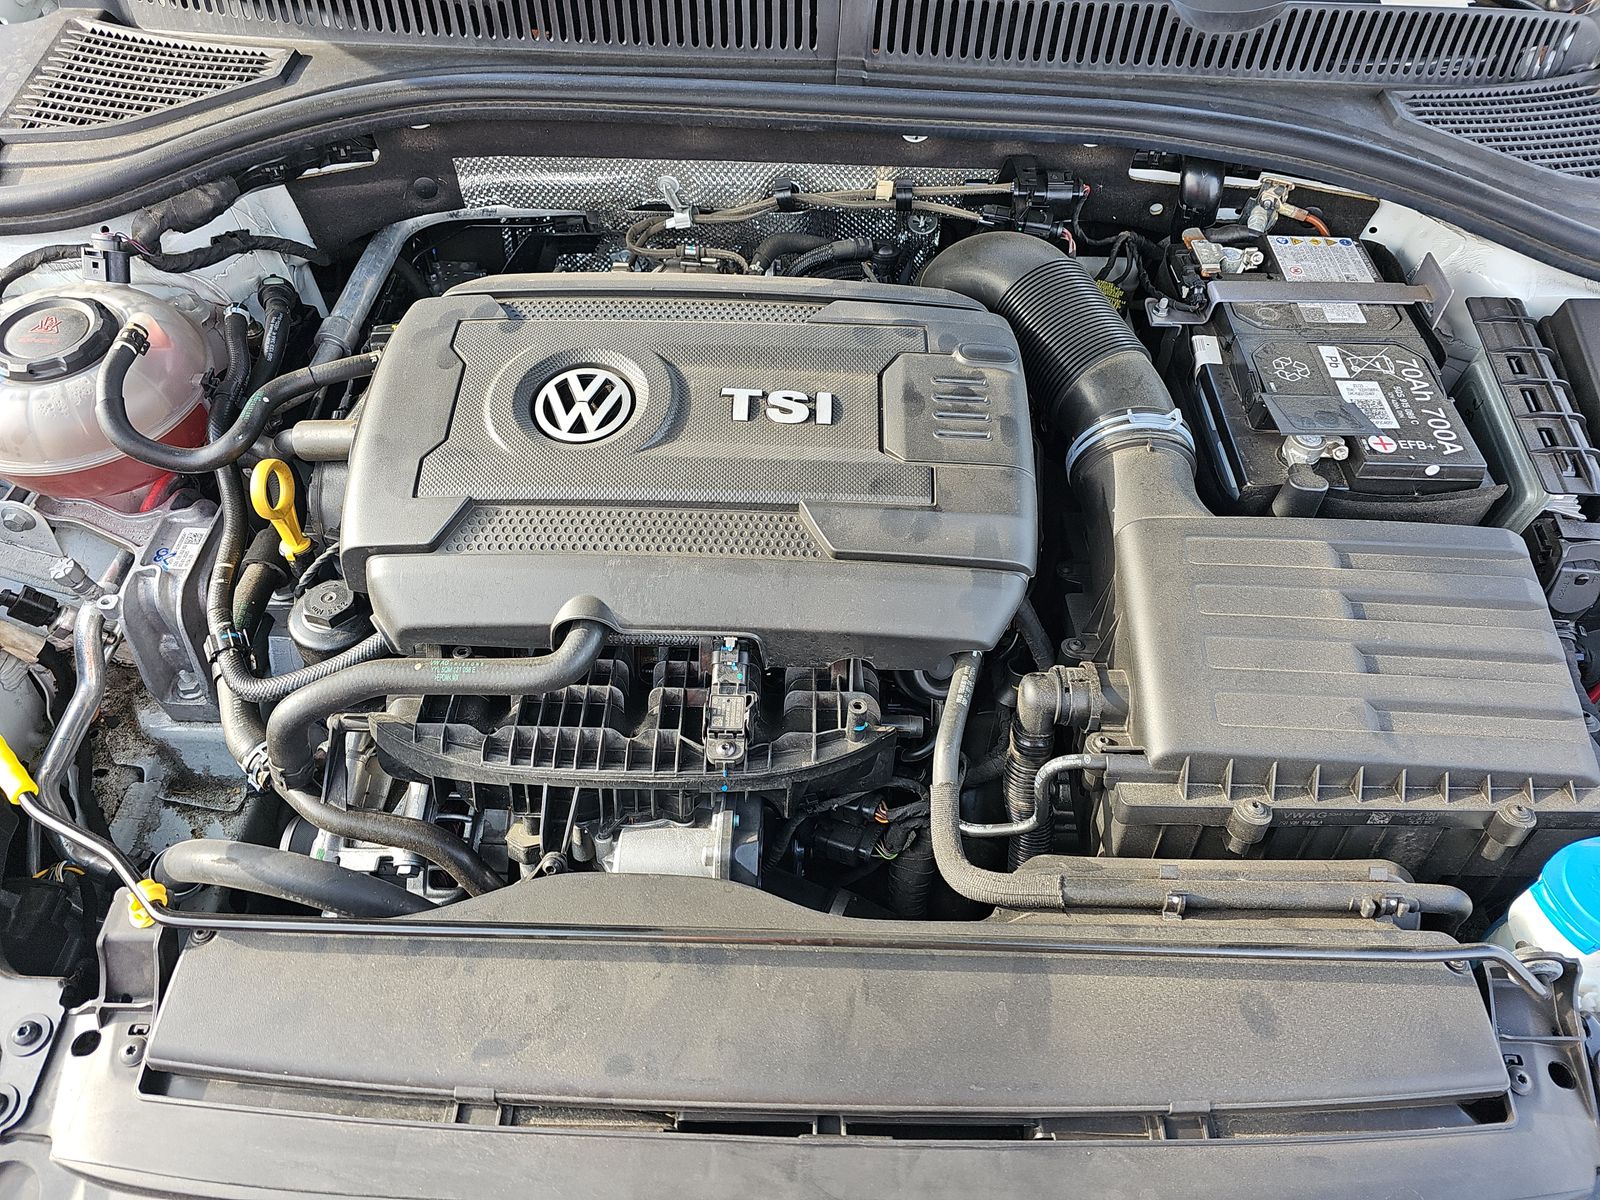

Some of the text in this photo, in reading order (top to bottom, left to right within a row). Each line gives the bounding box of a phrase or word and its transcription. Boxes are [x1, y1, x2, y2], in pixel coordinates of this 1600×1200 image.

[1325, 354, 1339, 369] Pb
[534, 367, 632, 443] VW
[720, 387, 833, 425] TSI
[1396, 358, 1435, 401] 70Ah
[1421, 408, 1464, 455] 700A
[1398, 440, 1436, 451] EFB+
